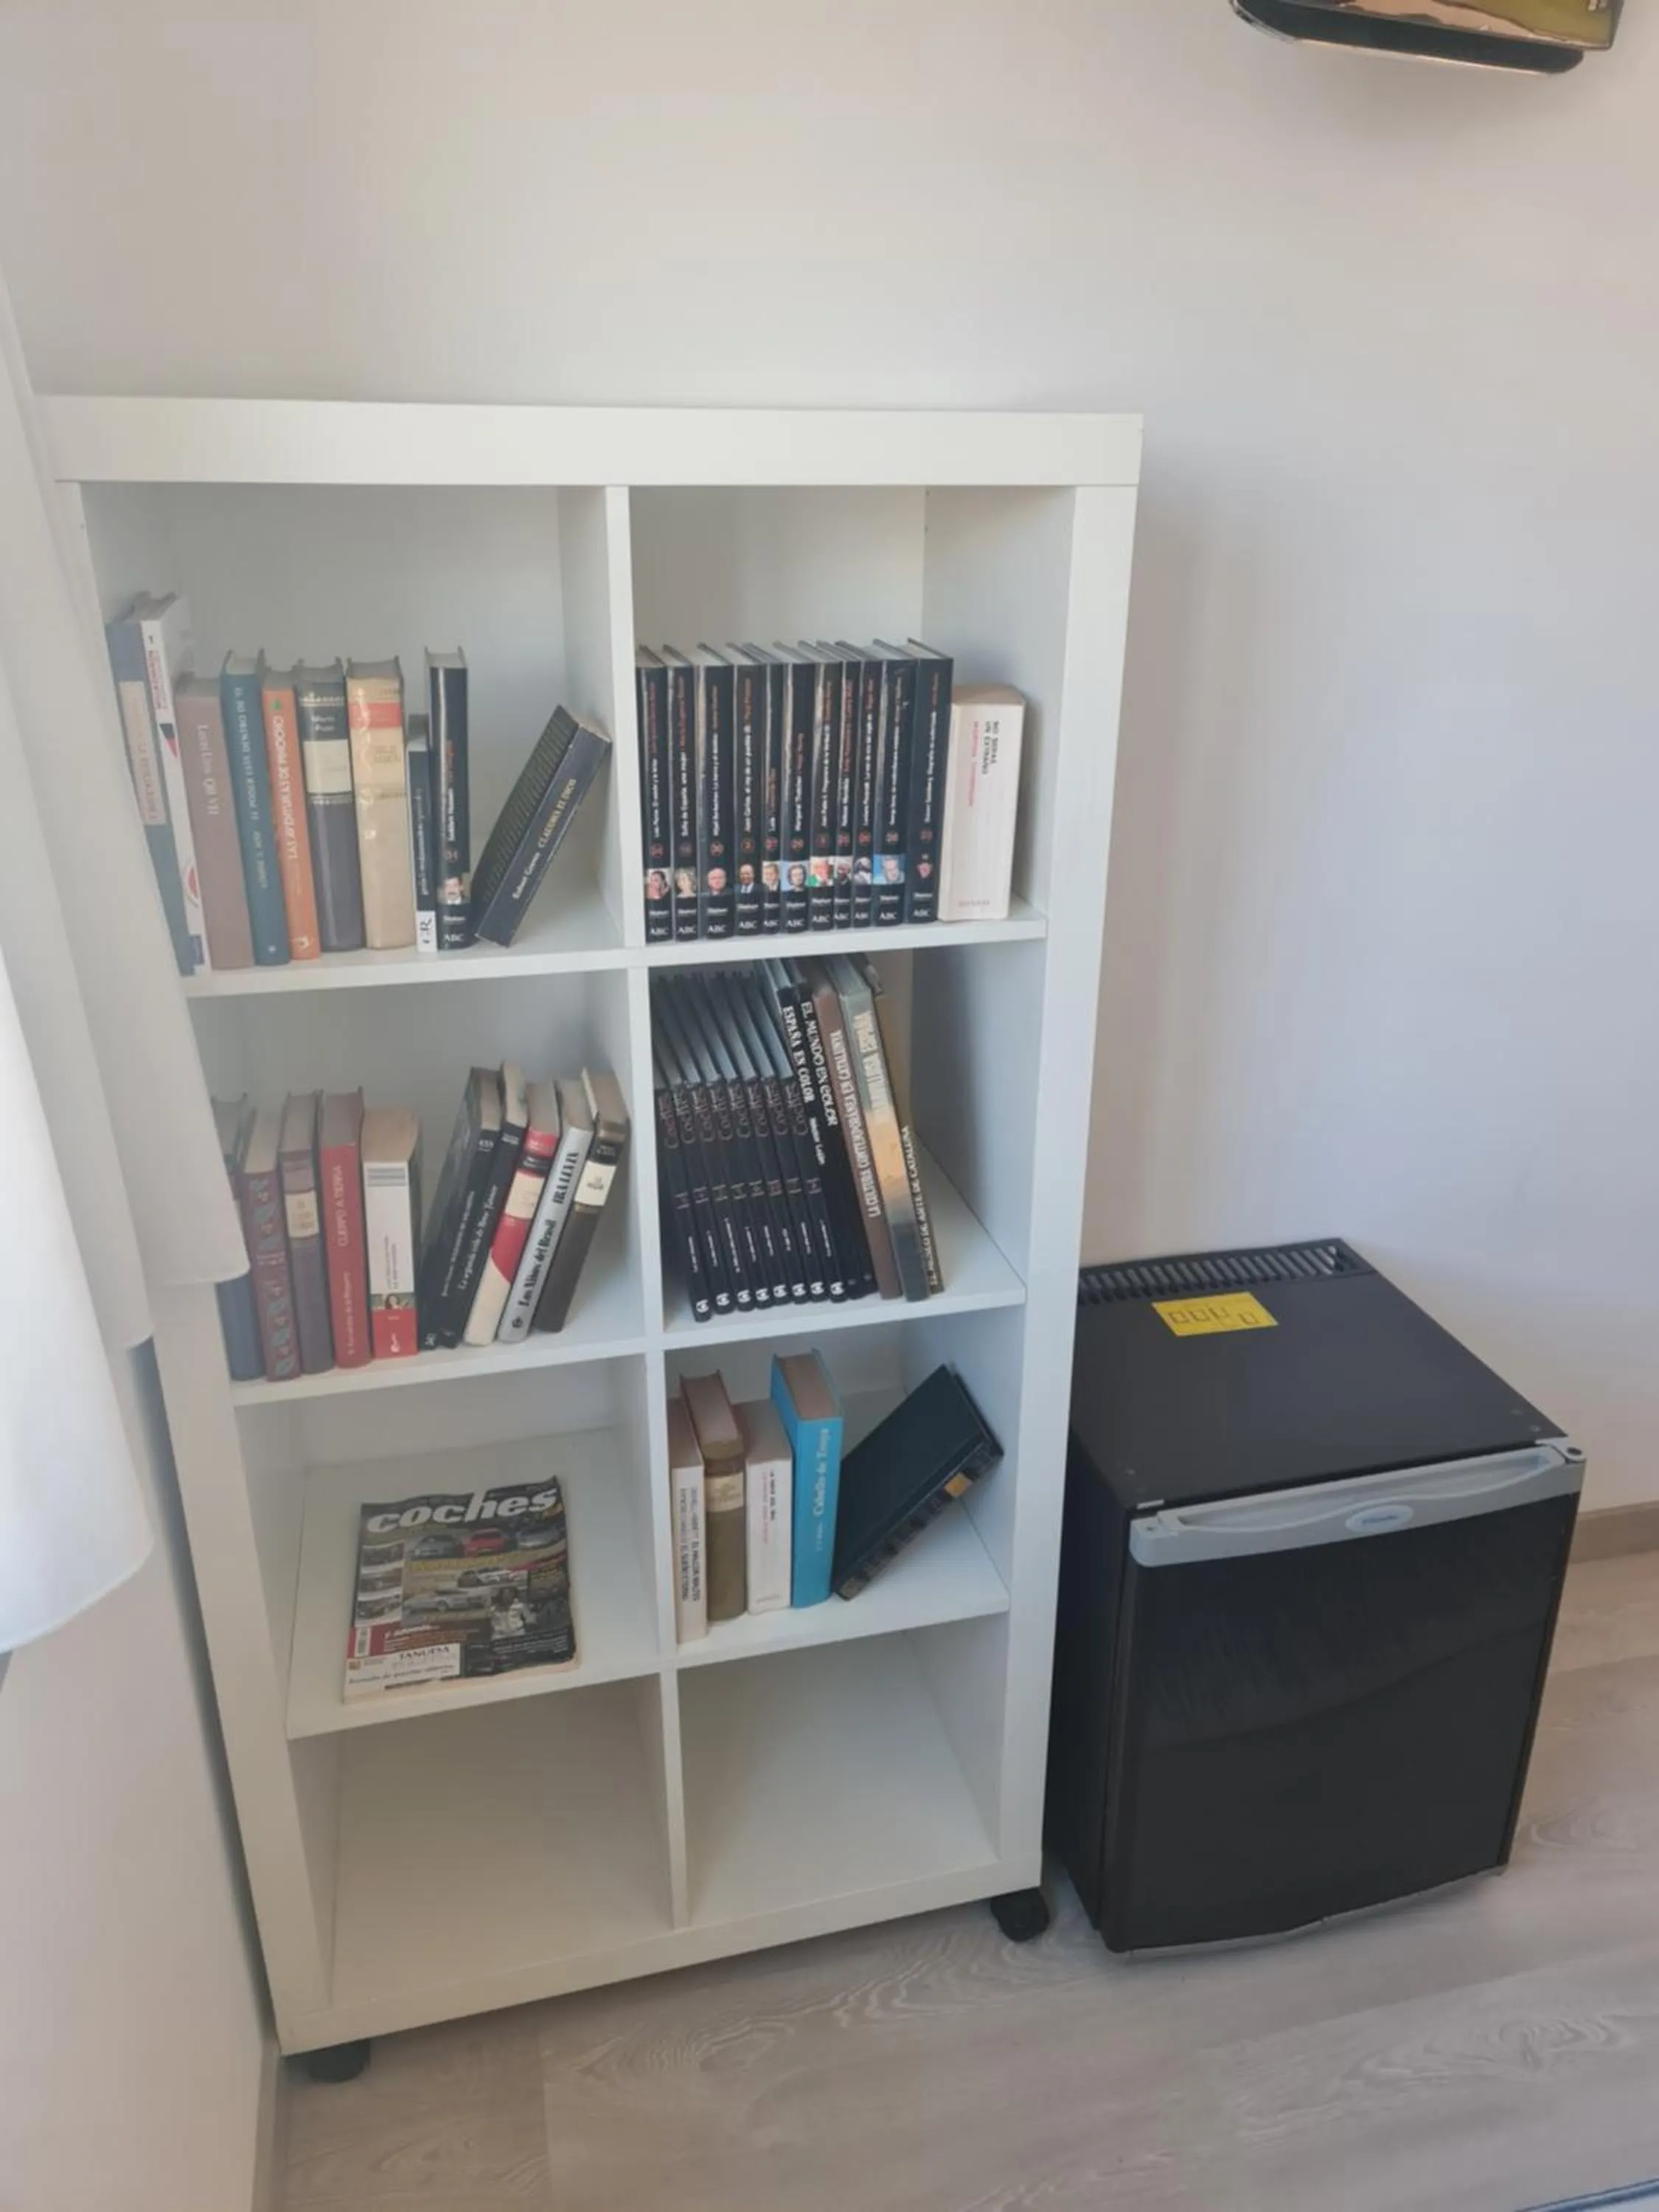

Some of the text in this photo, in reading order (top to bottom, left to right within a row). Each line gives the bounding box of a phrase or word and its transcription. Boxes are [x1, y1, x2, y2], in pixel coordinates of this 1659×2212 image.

[278, 779, 297, 840] AVENTURAS
[782, 1005, 802, 1048] ESPAÑA
[793, 1050, 806, 1067] EN
[801, 1001, 838, 1127] EL MUNDO EN COLOR
[796, 1067, 815, 1104] COLOR
[366, 1481, 557, 1533] coches
